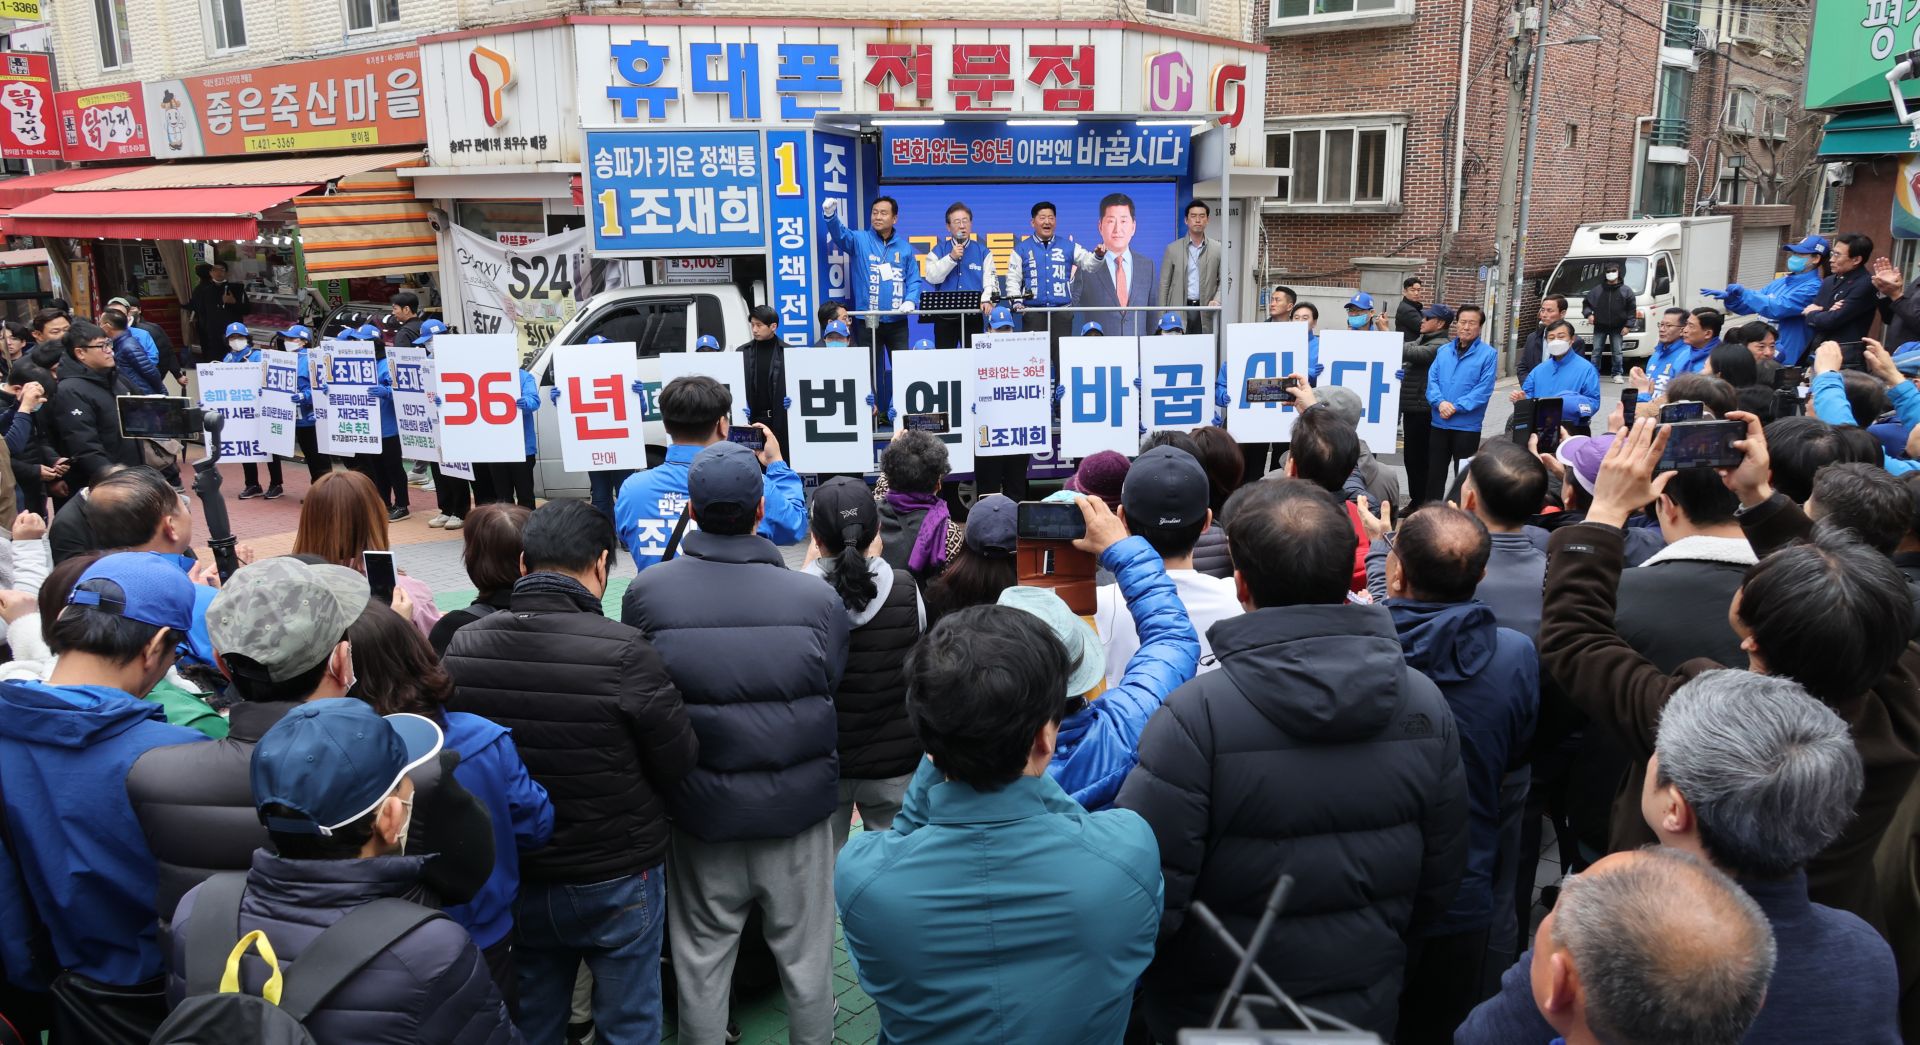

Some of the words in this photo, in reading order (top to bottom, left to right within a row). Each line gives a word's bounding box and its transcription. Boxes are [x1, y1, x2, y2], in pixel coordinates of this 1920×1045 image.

[0, 1, 39, 14] 1-3369
[606, 39, 843, 120] 휴대폰
[864, 43, 1096, 112] 전문점
[8, 88, 41, 141] 닭강정
[206, 67, 420, 135] 좋은축산마을
[84, 109, 133, 149] 닭강정
[350, 130, 371, 143] 방이점
[449, 139, 473, 154] 송파구
[503, 136, 529, 151] 최우수
[530, 135, 548, 151] 매장
[594, 146, 653, 180] 송파가
[657, 146, 695, 178] 키운
[699, 145, 756, 178] 정책통
[892, 137, 969, 166] 변화없는
[970, 138, 1015, 166] 36년
[1016, 139, 1072, 167] 이번엔
[1076, 135, 1184, 167] 바꿉시다
[774, 141, 802, 197] 1
[598, 188, 624, 237] 1
[630, 185, 760, 235] 조재희
[508, 253, 573, 300] S24
[1050, 247, 1067, 298] 조재희
[334, 360, 377, 384] 조재희
[977, 366, 1021, 380] 변화없는
[1022, 365, 1045, 378] 36년
[203, 388, 228, 402] 송파
[440, 371, 518, 426] 36
[567, 373, 630, 441] 년
[993, 384, 1046, 401] 바꿉시다!
[1071, 366, 1130, 428] 바
[1151, 363, 1206, 426] 꿉
[232, 406, 256, 420] 사람
[337, 408, 369, 420] 재건축
[338, 421, 353, 434] 신속
[355, 422, 370, 435] 추진
[799, 378, 859, 443] 번
[978, 424, 991, 448] 1
[991, 425, 1047, 447] 조재희
[591, 450, 617, 466] 만에
